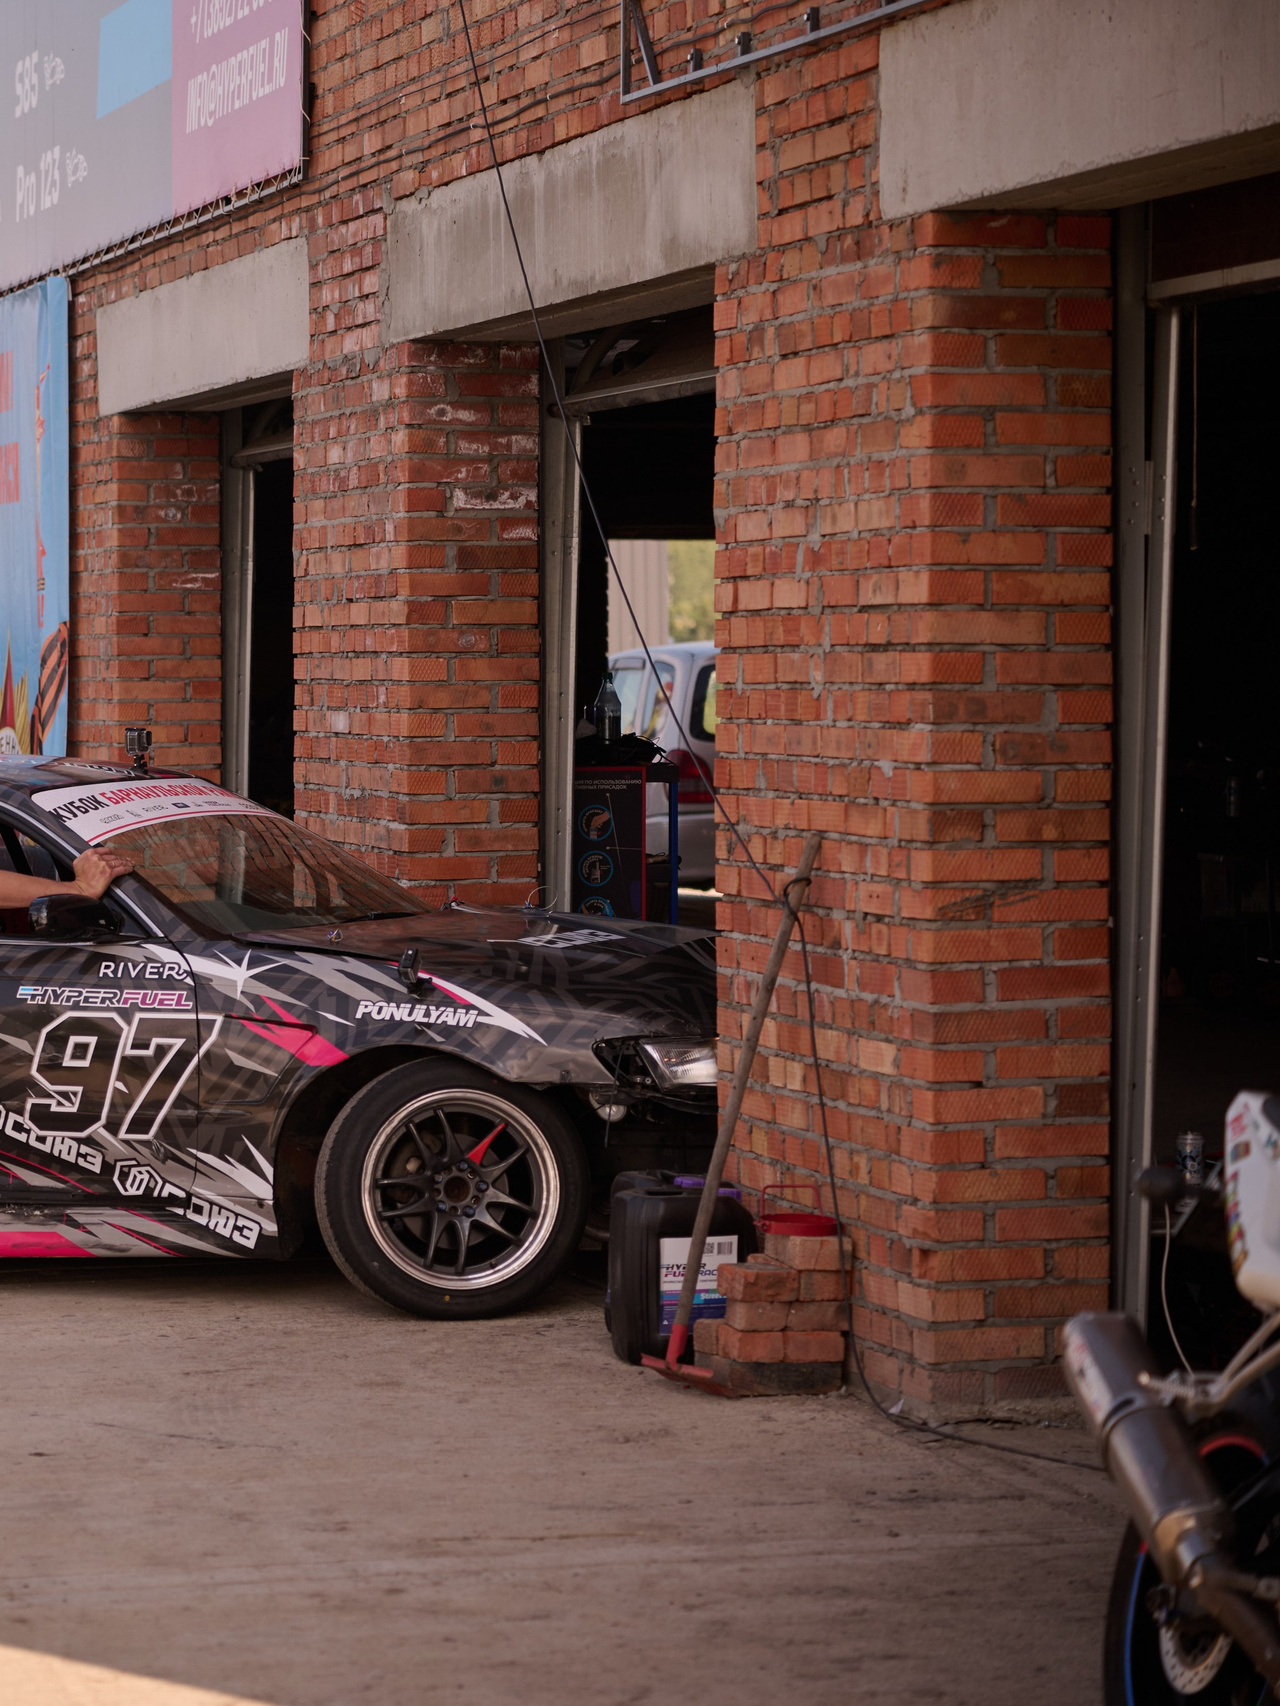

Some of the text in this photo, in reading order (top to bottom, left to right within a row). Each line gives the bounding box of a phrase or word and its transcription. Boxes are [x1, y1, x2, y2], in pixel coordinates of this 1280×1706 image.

[185, 27, 288, 134] INFO@HYPERFUEL.RU
[16, 145, 60, 223] Pro 123
[48, 794, 110, 823] КУБОК
[98, 783, 209, 806] БАРНАУЛЬСКОЙ
[99, 961, 187, 980] RIVER
[355, 1000, 479, 1028] PONULYAM
[24, 1011, 221, 1140] 97
